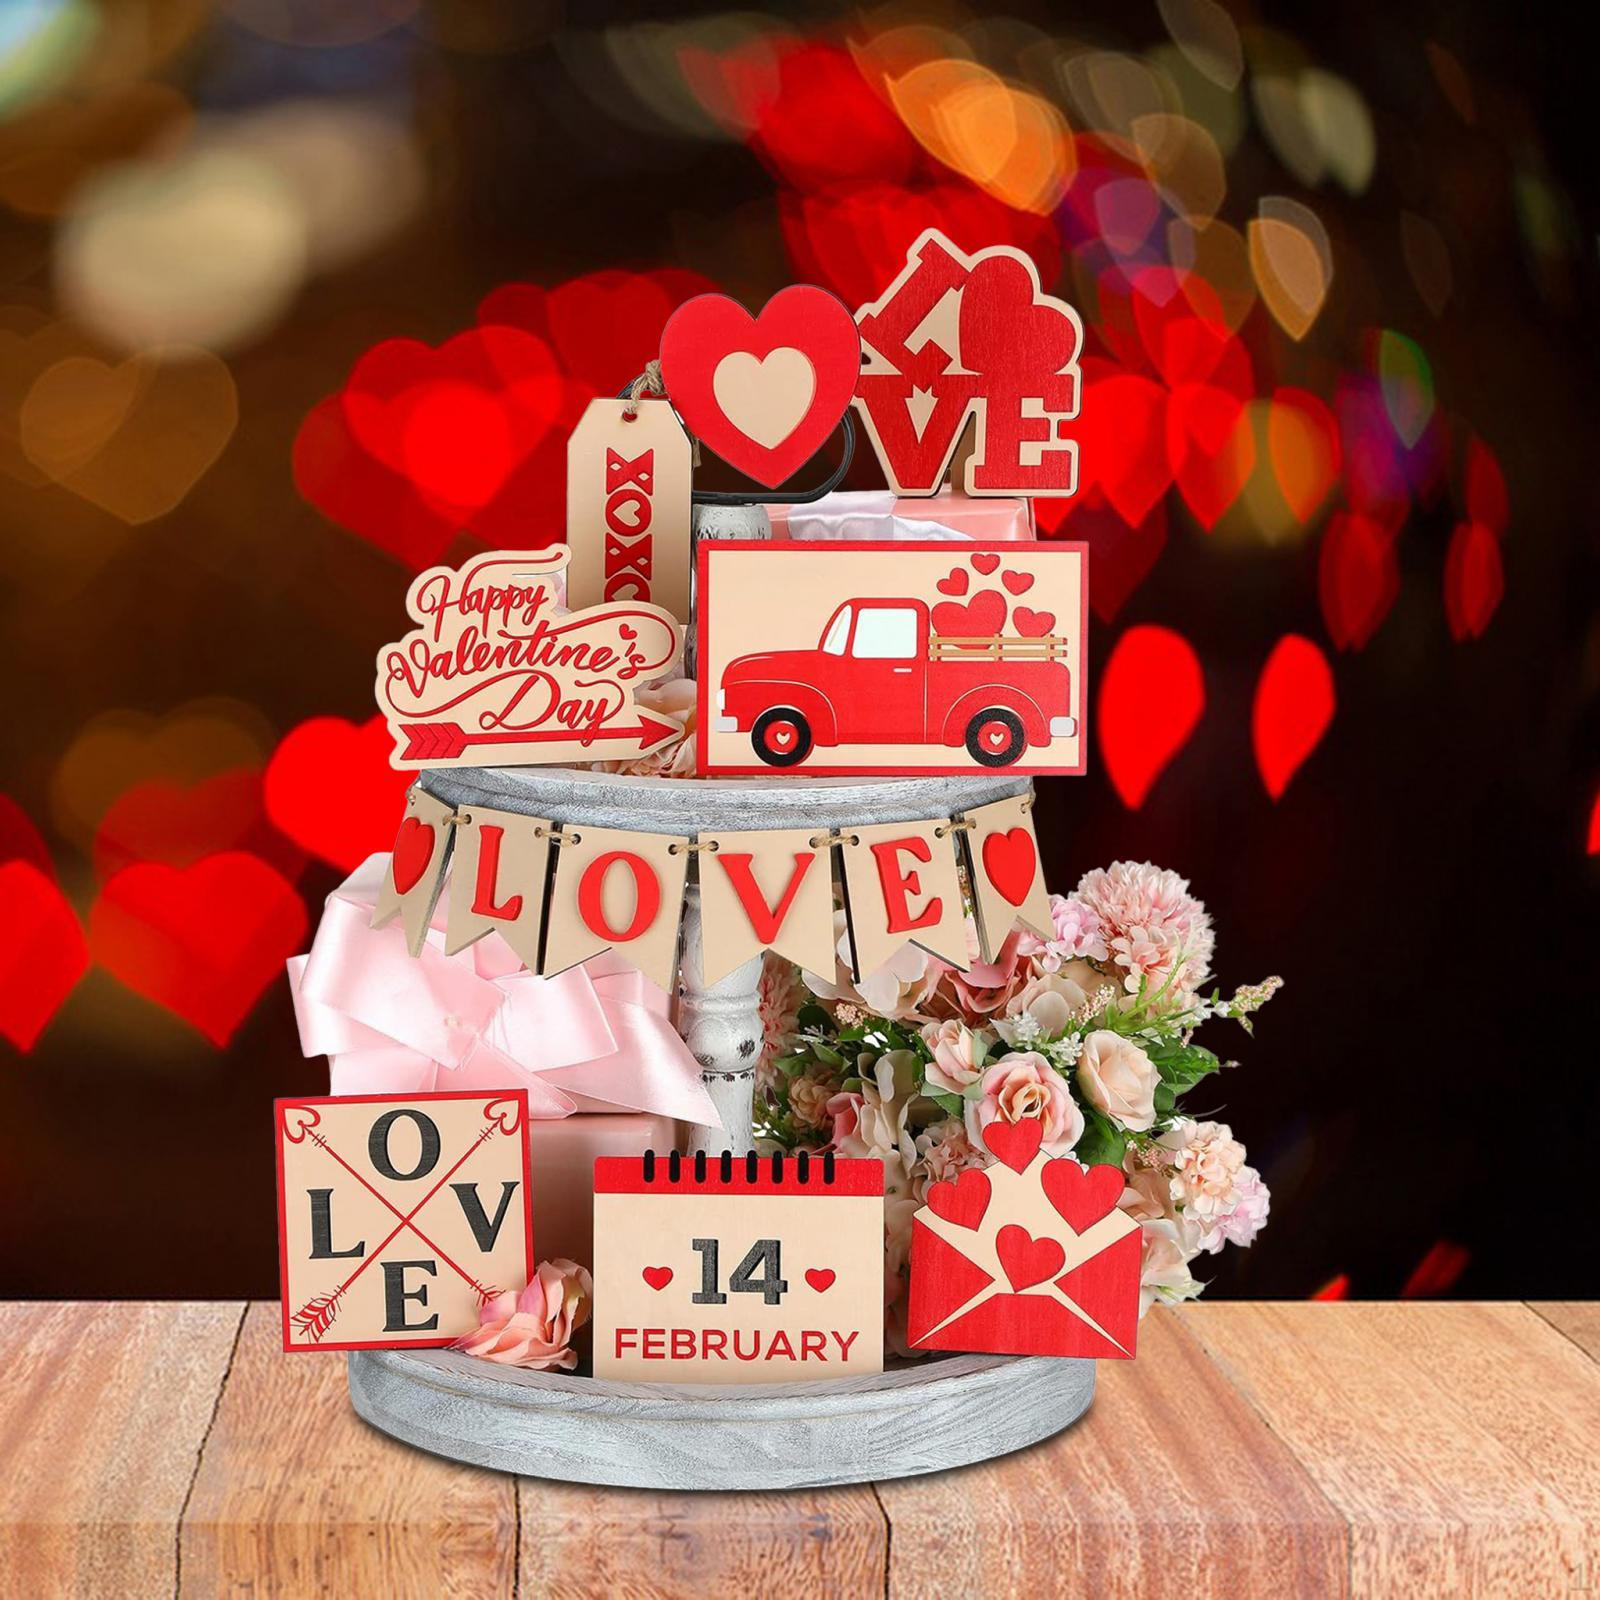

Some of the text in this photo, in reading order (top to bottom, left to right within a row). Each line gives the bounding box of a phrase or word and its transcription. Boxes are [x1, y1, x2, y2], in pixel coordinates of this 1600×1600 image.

[416, 560, 560, 642] Happy
[387, 618, 652, 698] Valentine's
[478, 669, 626, 748] Day
[691, 1238, 788, 1305] 14
[614, 1328, 859, 1361] FEBRUARY
